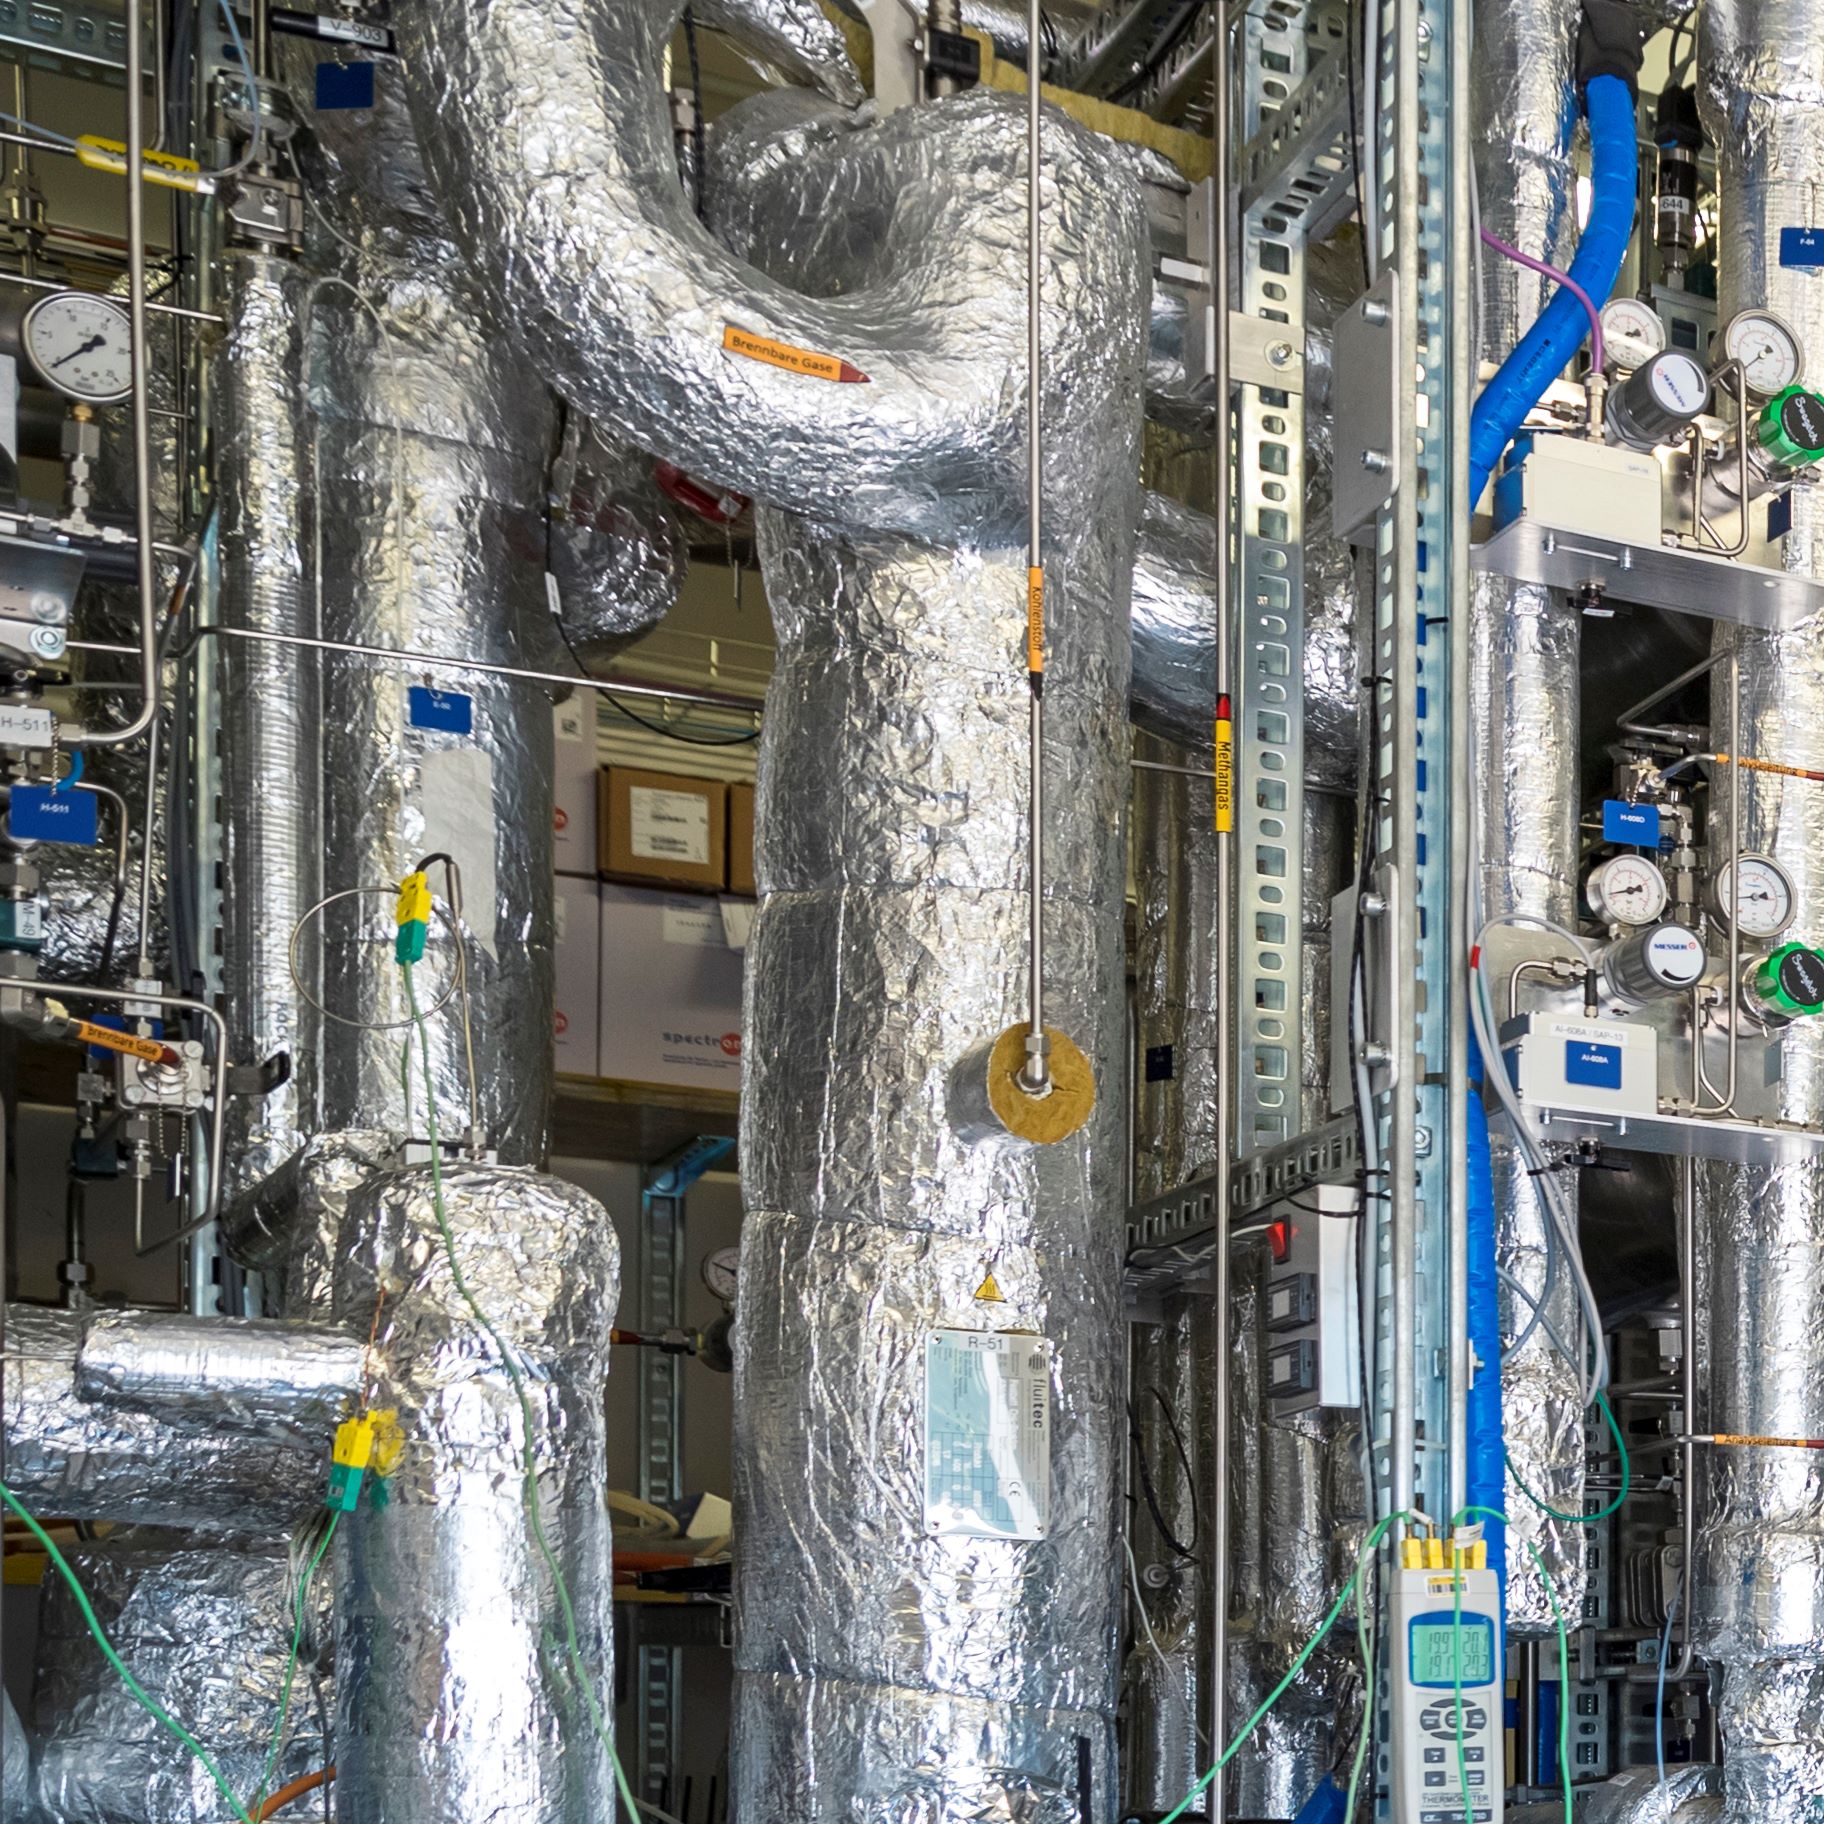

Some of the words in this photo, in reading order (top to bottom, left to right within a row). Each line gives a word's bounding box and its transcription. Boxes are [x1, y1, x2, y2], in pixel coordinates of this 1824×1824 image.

[732, 334, 800, 364] Brennbare
[802, 356, 834, 375] Gase
[1794, 396, 1818, 446] Swagelok
[1791, 954, 1818, 1000] Swagelok
[1032, 1378, 1046, 1429] fluitec
[1422, 1795, 1489, 1804] THERMOTER
